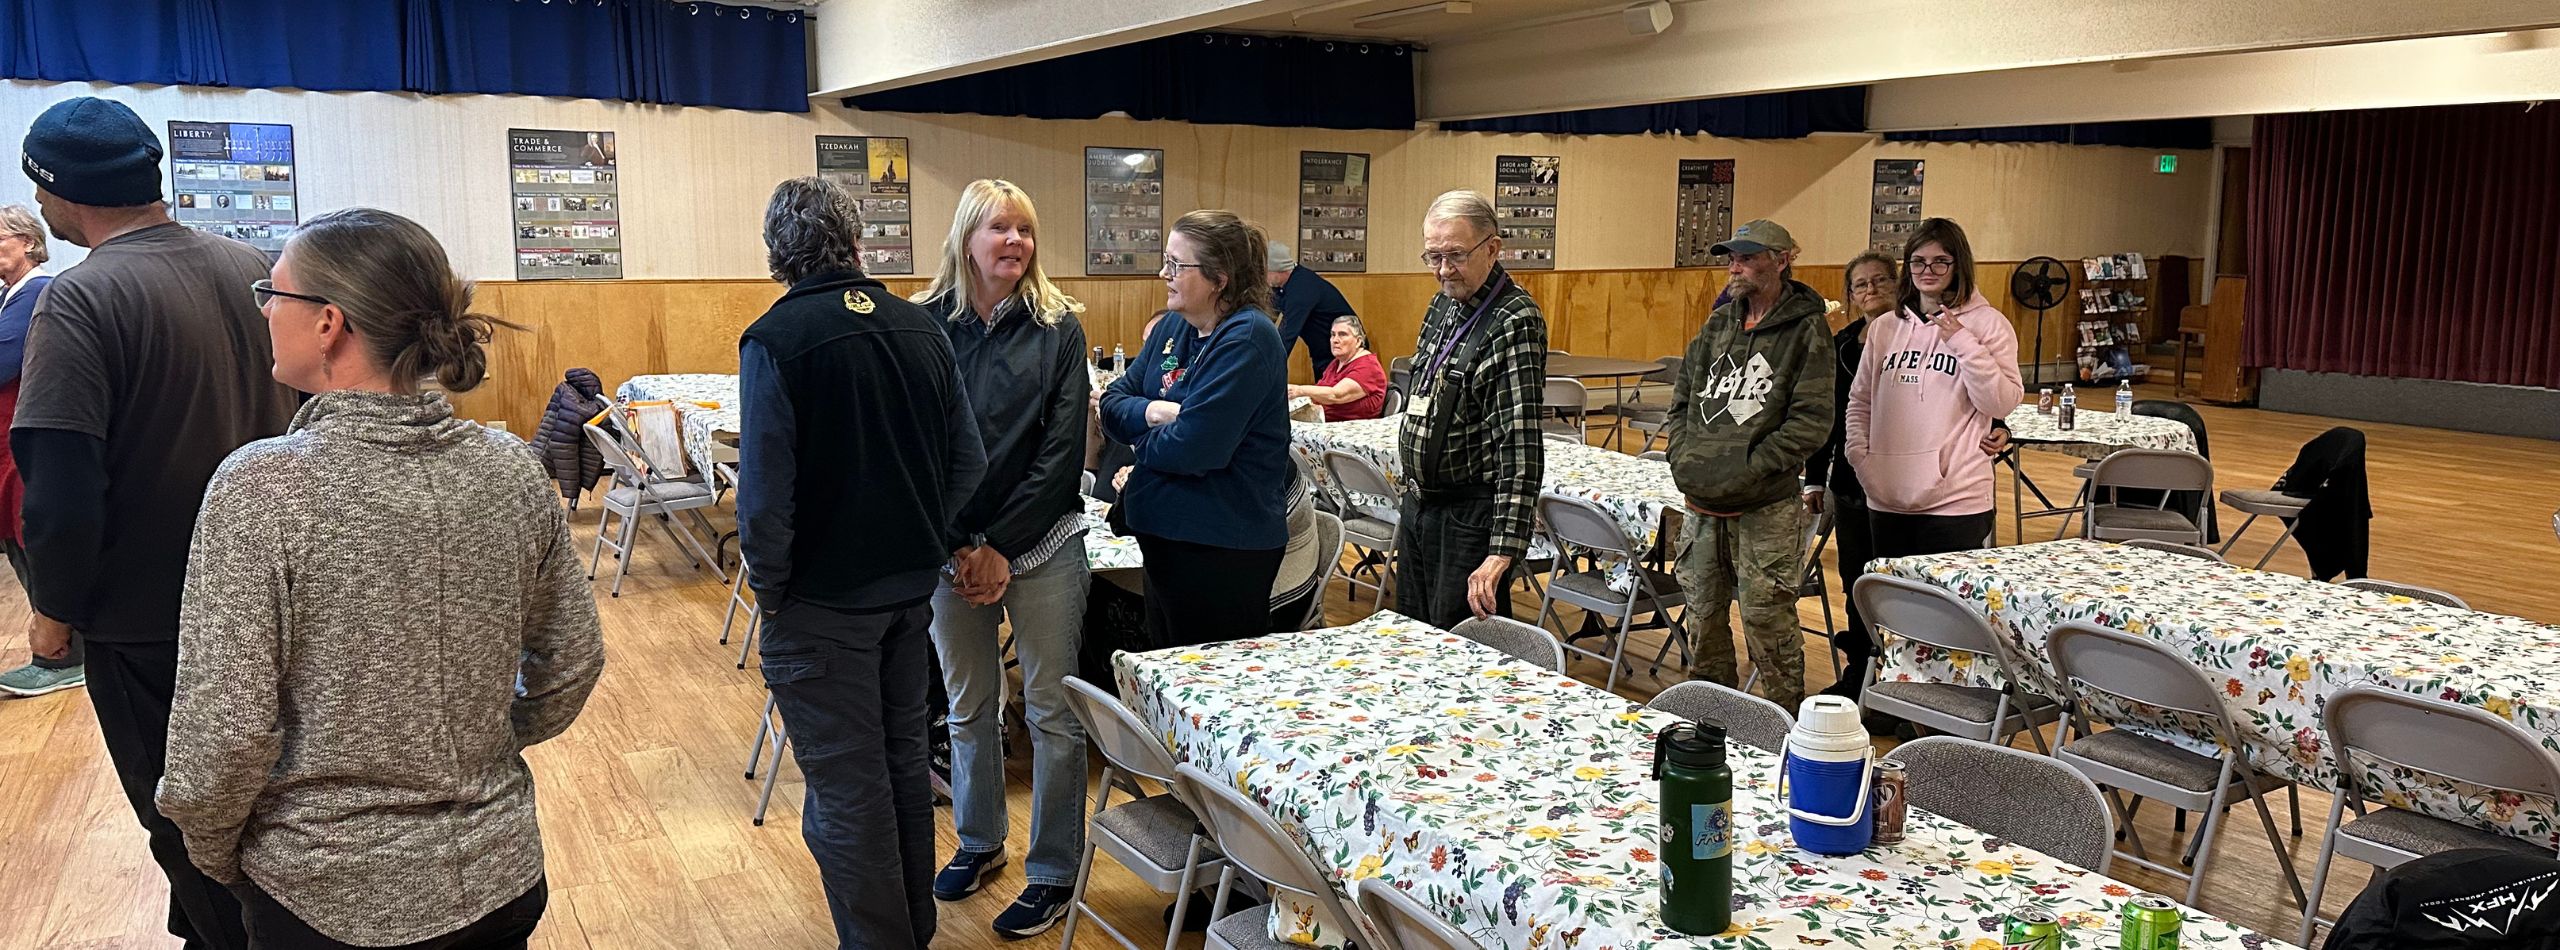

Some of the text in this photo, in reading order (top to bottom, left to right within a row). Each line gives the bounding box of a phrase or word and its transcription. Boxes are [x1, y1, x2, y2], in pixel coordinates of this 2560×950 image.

[174, 130, 213, 138] LIBERTY
[513, 137, 541, 145] TRADE
[513, 145, 562, 153] COMMERCE
[1900, 374, 1919, 383] MASS
[2513, 871, 2557, 887] ESTABLISH
[2488, 885, 2510, 894] YOUR
[2450, 892, 2486, 903] JOURNEY
[2468, 892, 2517, 914] HFX
